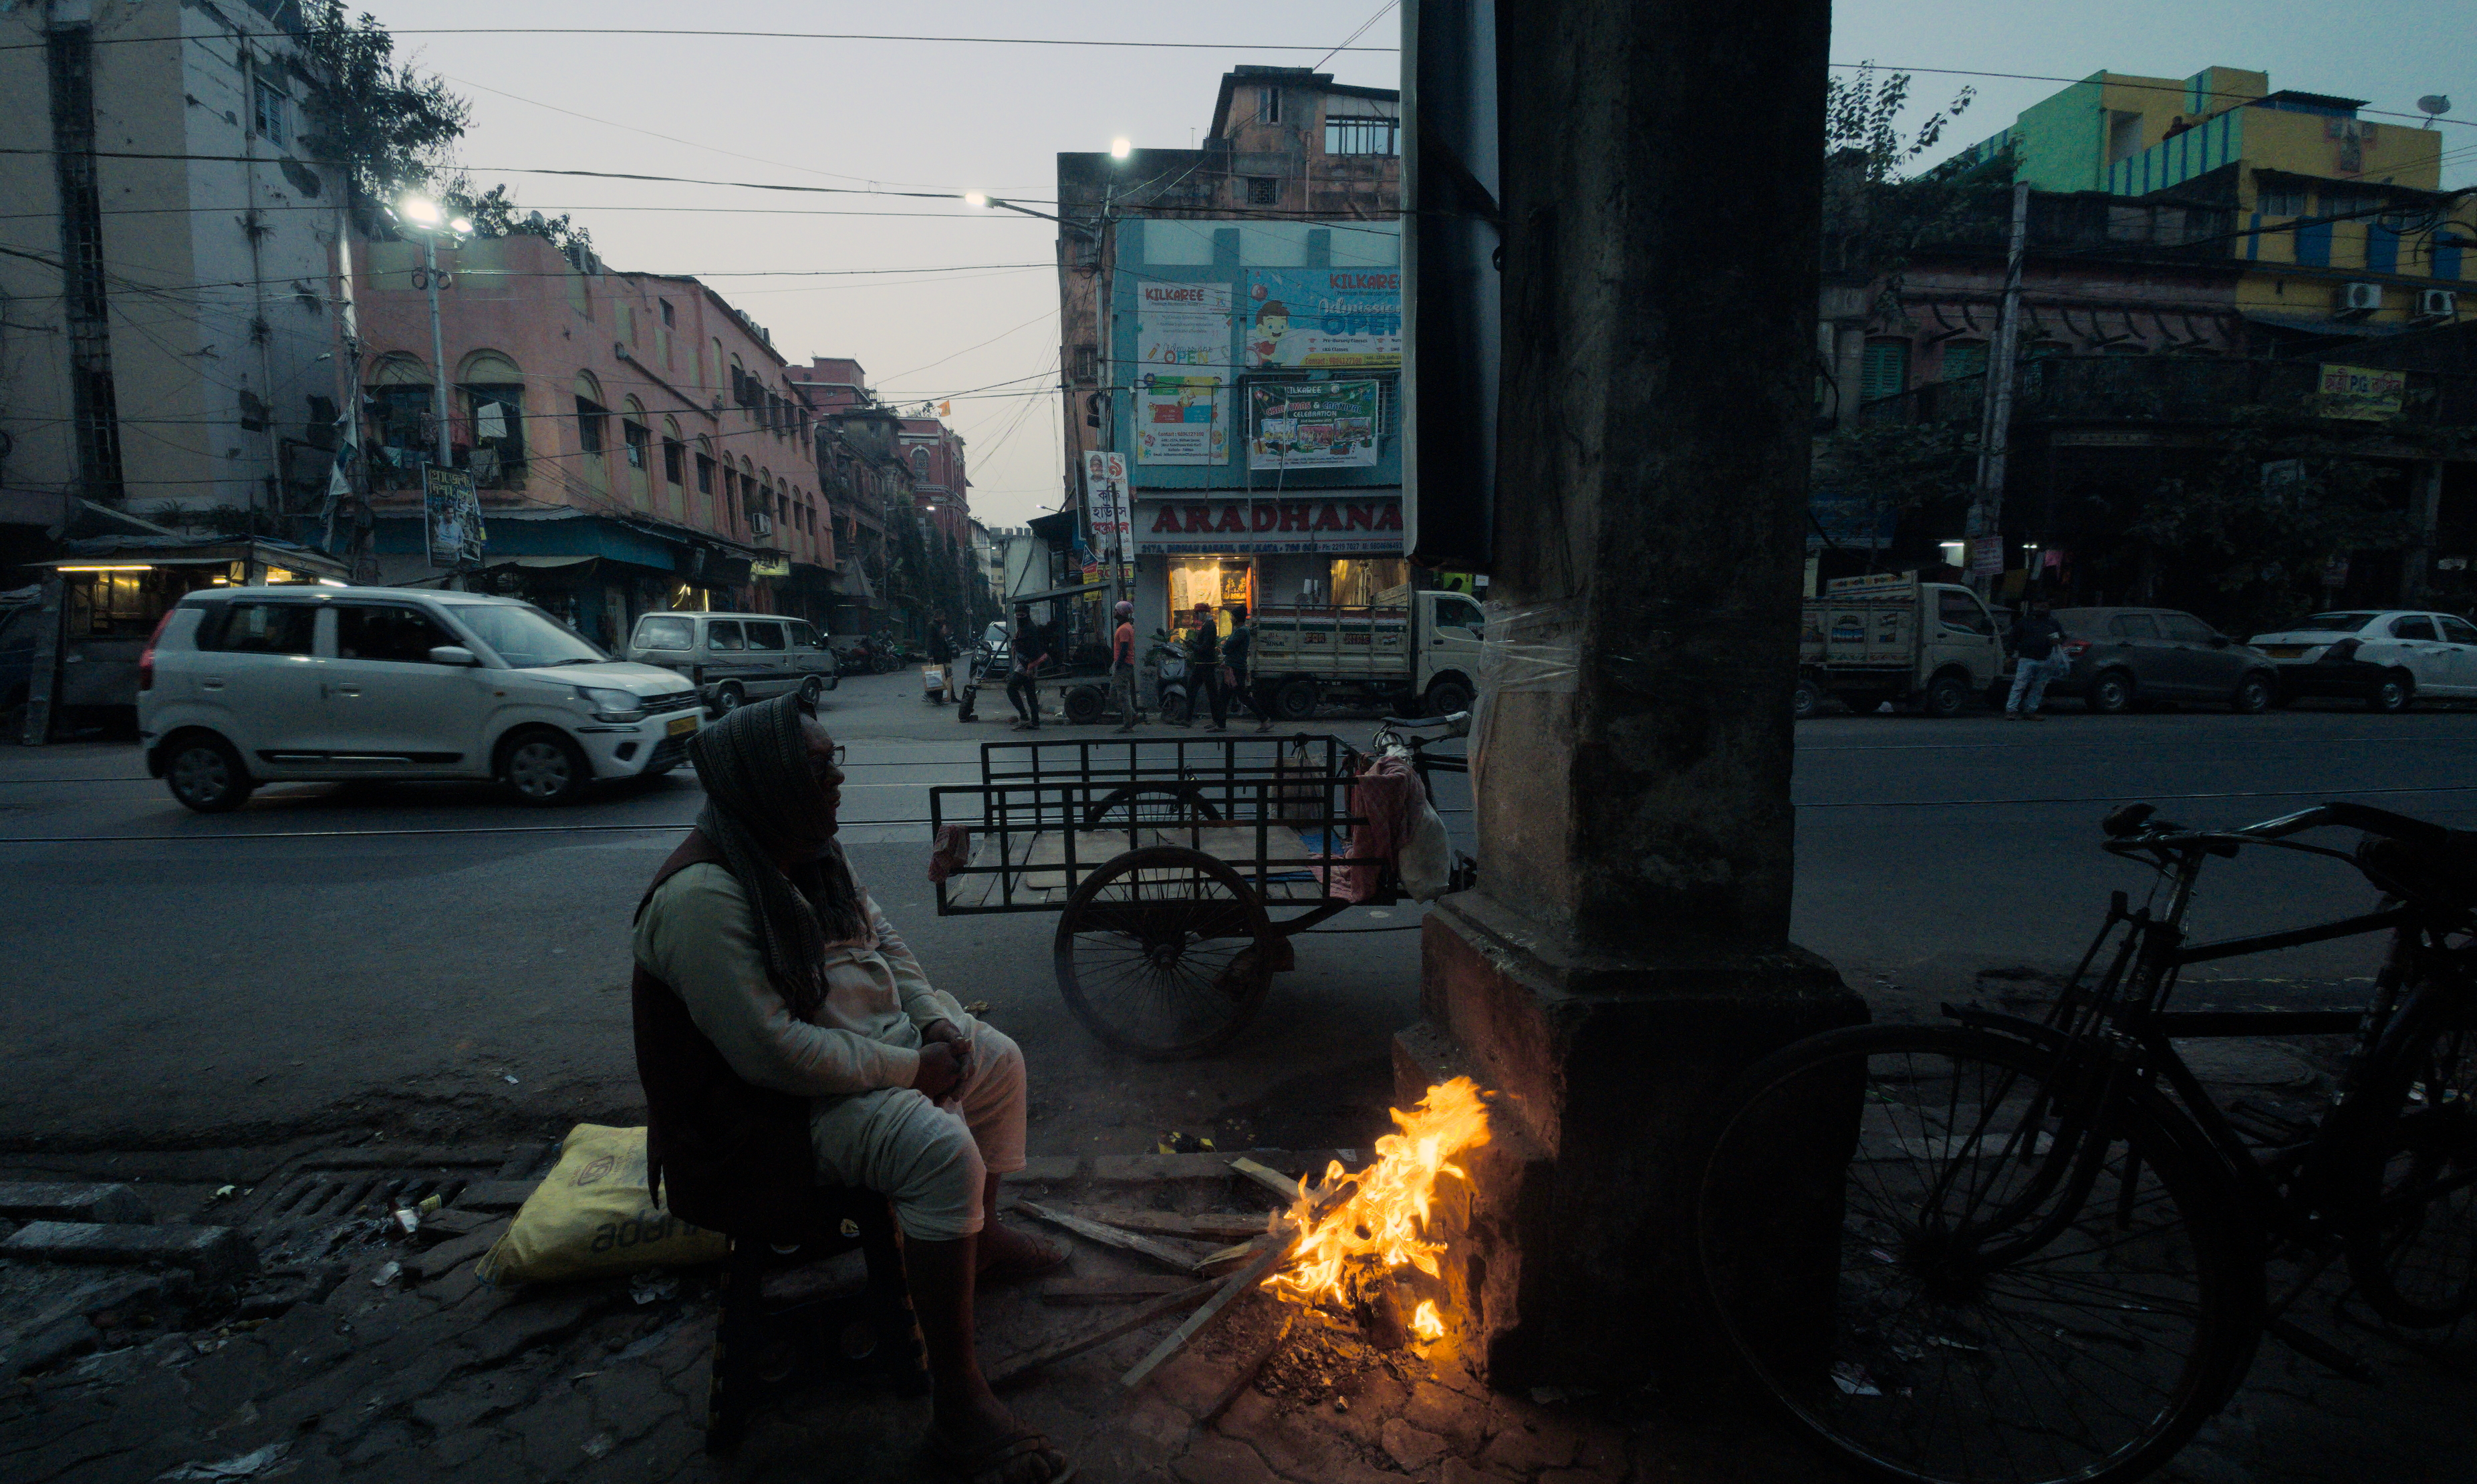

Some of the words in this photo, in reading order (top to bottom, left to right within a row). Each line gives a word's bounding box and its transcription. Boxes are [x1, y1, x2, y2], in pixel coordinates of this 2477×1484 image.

[1329, 273, 1401, 289] KILKARE
[1145, 288, 1204, 301] KILKAREE
[1164, 351, 1208, 364] OPEN
[2350, 375, 2368, 392] PG
[1266, 402, 1311, 416] CHRITMAS
[1323, 402, 1362, 414] CARNIVAL
[1152, 504, 1403, 533] ARADHANA
